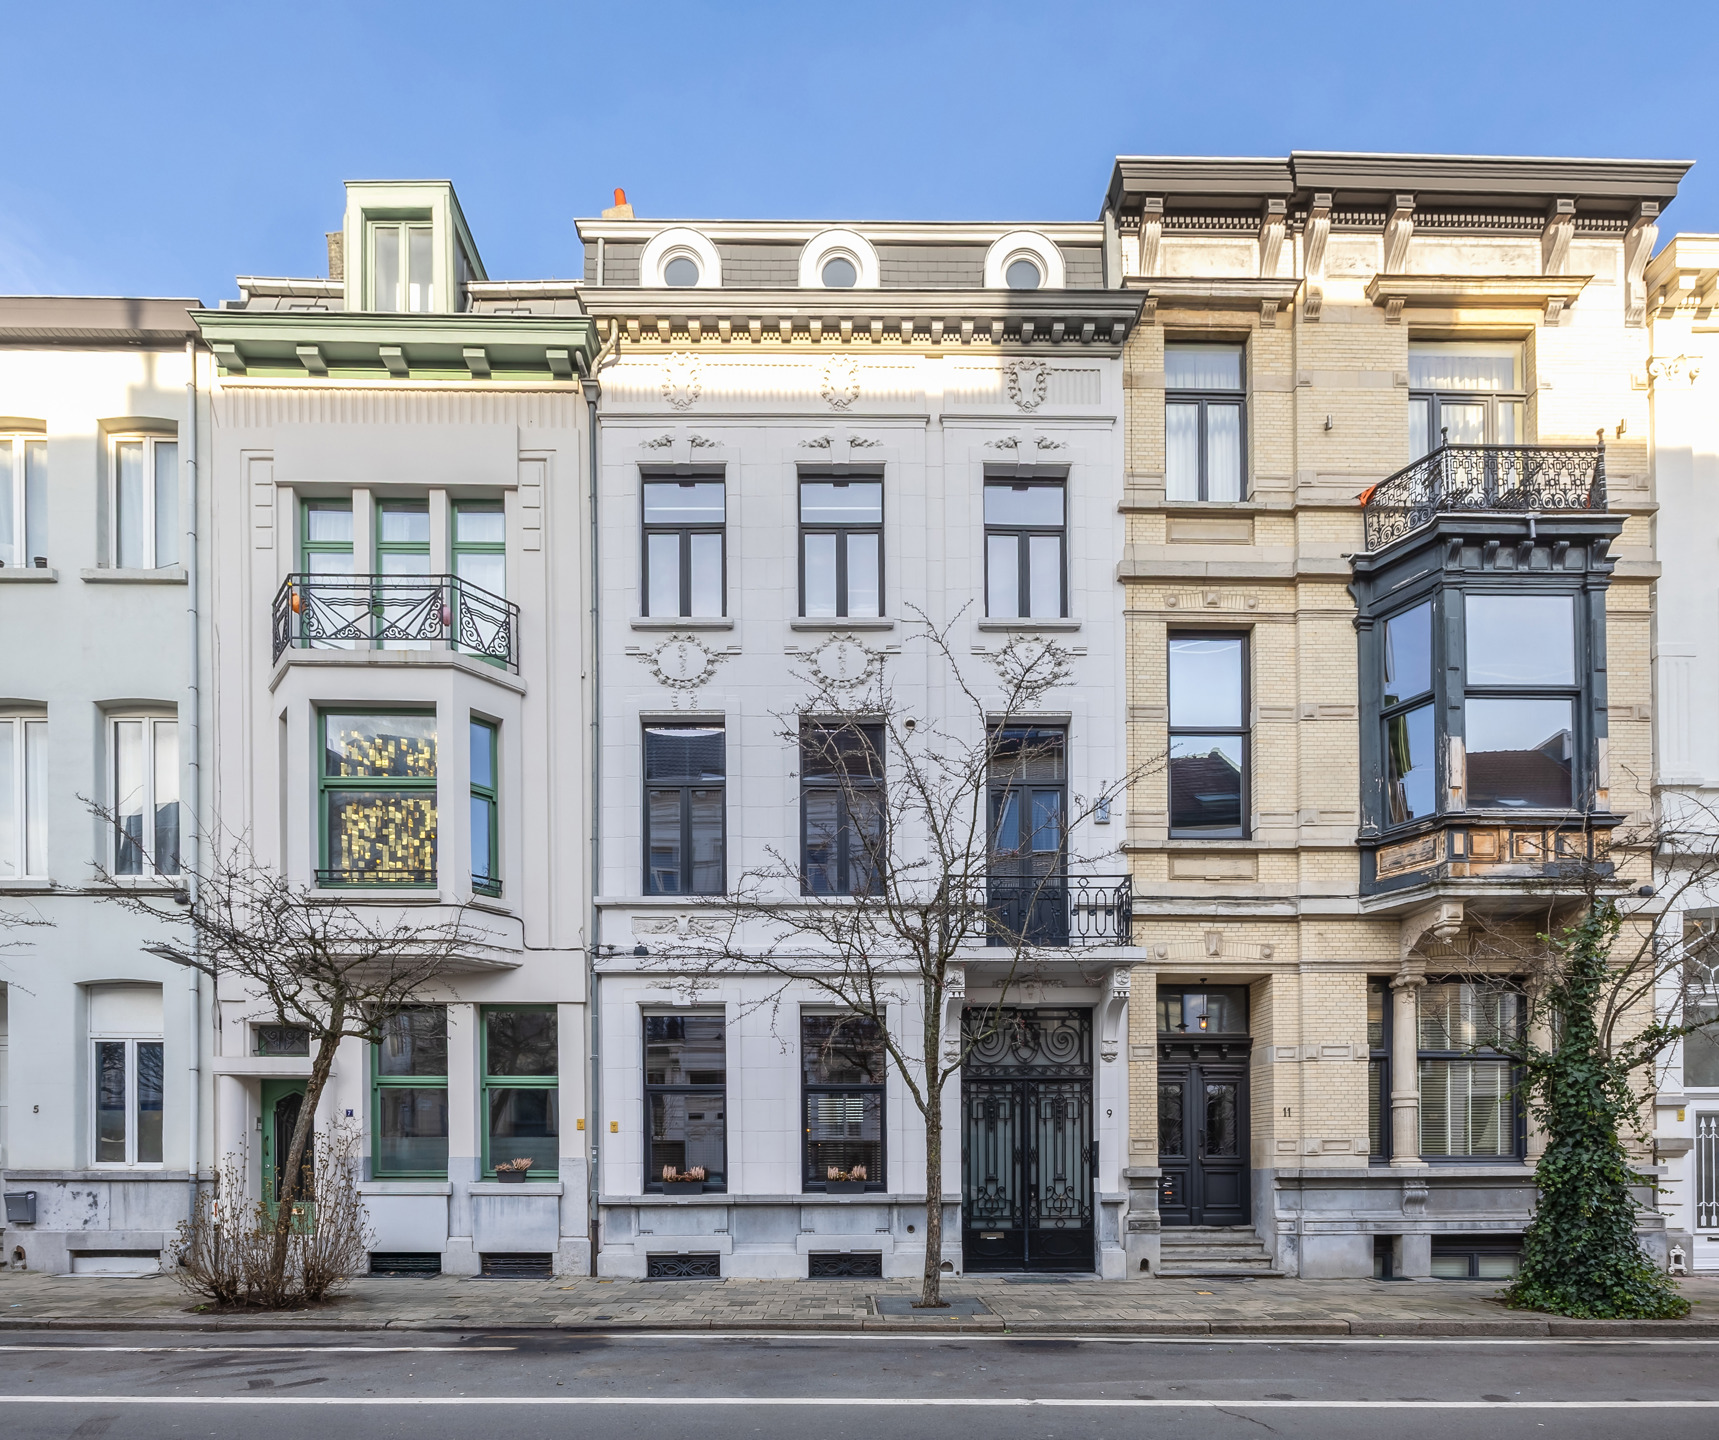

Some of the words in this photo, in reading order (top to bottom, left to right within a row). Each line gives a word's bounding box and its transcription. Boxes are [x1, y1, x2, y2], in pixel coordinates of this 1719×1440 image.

[33, 1105, 39, 1114] 5
[1106, 1109, 1113, 1118] 9
[1283, 1107, 1291, 1117] 11
